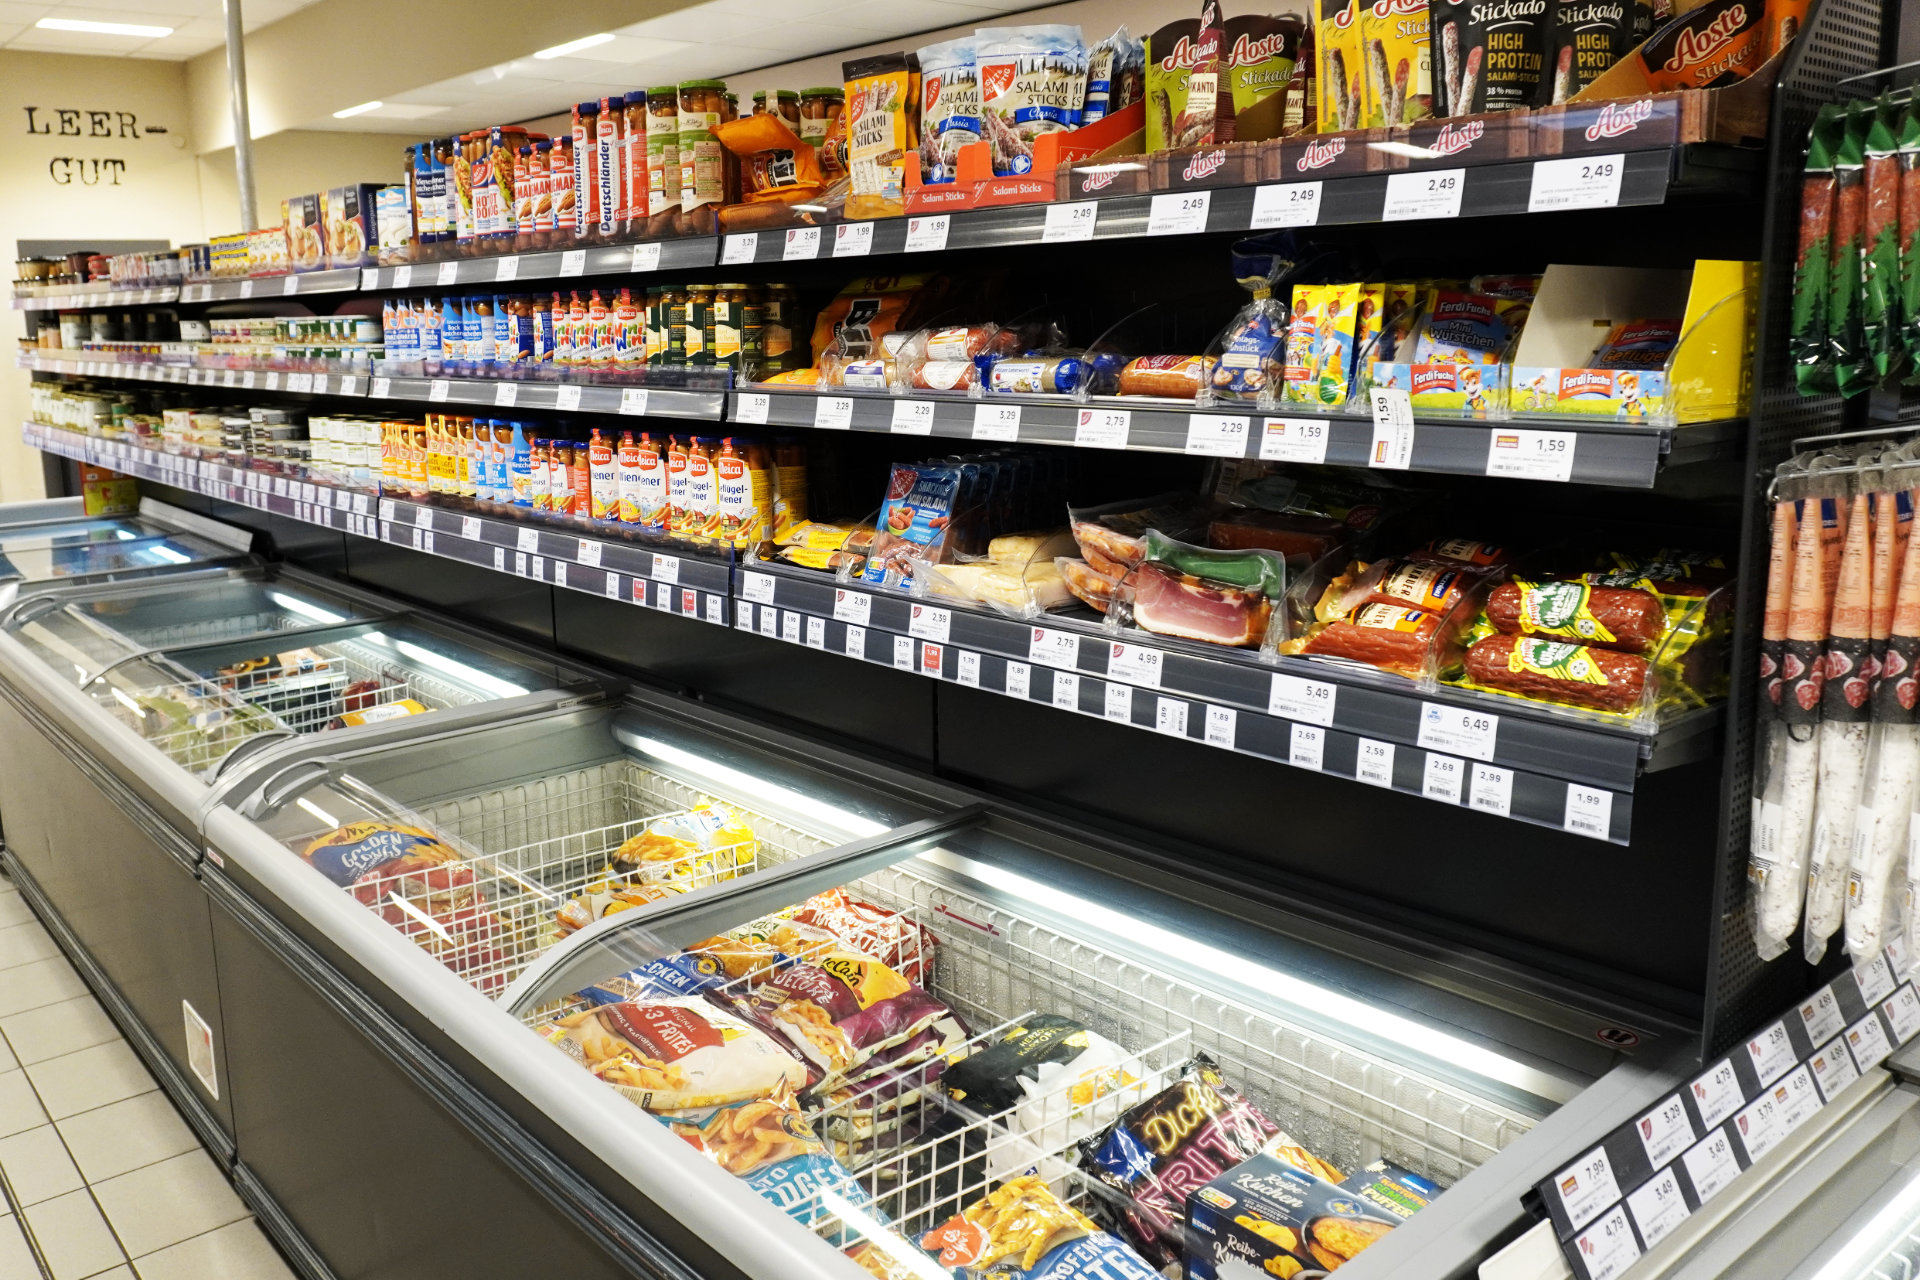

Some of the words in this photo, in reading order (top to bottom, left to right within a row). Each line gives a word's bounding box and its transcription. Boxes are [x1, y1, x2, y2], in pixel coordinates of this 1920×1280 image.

[1468, 0, 1545, 26] Stickado
[1557, 4, 1623, 27] Stickado
[1395, 20, 1431, 39] Stick
[1487, 33, 1523, 51] HIGH
[1576, 33, 1610, 50] HIGH
[1664, 3, 1747, 74] Aoste
[1228, 33, 1284, 72] Aoste
[1487, 51, 1543, 70] PROTEIN
[1015, 81, 1069, 94] SALAMI
[1486, 86, 1496, 96] 38
[940, 91, 978, 106] SALAMI
[1027, 94, 1068, 107] STICKS
[946, 104, 978, 116] SICKS
[24, 106, 168, 139] LEER-
[858, 114, 887, 133] SALAMI
[1585, 99, 1653, 142] Aoste
[855, 129, 883, 148] STICKS
[1429, 119, 1485, 156] Aoste
[1296, 136, 1346, 172] Aoste
[50, 157, 126, 186] GUT
[1183, 149, 1226, 181] Aoste
[1582, 164, 1613, 180] 2,49
[575, 145, 584, 234] Deutschländer
[599, 139, 612, 232] Deutschländer
[992, 185, 1018, 196] Salami
[1019, 183, 1042, 194] Sticks
[1428, 178, 1455, 192] 2,49
[922, 193, 944, 203] Salami
[944, 191, 965, 202] Sticks
[1290, 190, 1314, 203] 2,49
[1182, 199, 1204, 210] 2,49
[1073, 208, 1092, 220] 2,49
[856, 227, 870, 237] 1,99
[930, 222, 945, 231] 1,99
[804, 231, 818, 242] 2,49
[1439, 301, 1464, 313] Ferdi
[1466, 302, 1492, 316] Fuchs
[1449, 321, 1472, 333] Mini
[1429, 327, 1495, 348] Würstchen
[1414, 371, 1433, 386] Ferdi
[1433, 370, 1455, 383] Fuchs
[1562, 374, 1584, 388] Ferdi
[1585, 373, 1612, 387] Fuchs
[836, 401, 849, 411] 2,29
[914, 405, 930, 416] 2,29
[1378, 397, 1390, 424] 1,59
[999, 410, 1016, 421] 3,29
[1105, 416, 1125, 428] 2,79
[1221, 422, 1243, 435] 2,29
[1298, 426, 1322, 439] 1,59
[1536, 438, 1566, 453] 1,59
[619, 451, 639, 463] Meic
[719, 462, 742, 475] Meica
[640, 476, 661, 486] ener
[760, 579, 772, 587] 1,59
[854, 597, 868, 607] 2,99
[932, 613, 947, 623] 2,39
[898, 641, 910, 649] 2,79
[1057, 637, 1075, 649] 2,79
[962, 655, 975, 665] 1,79
[1138, 652, 1157, 665] 4,99
[1011, 666, 1025, 675] 1,89
[1058, 676, 1073, 686] 2,49
[1111, 689, 1126, 699] 1,99
[1306, 685, 1329, 700] 5,49
[1212, 711, 1229, 722] 1,89
[1462, 716, 1490, 732] 6,49
[1297, 730, 1316, 741] 2,69
[1365, 745, 1385, 757] 2,59
[1433, 760, 1454, 772] 2,69
[1479, 771, 1502, 783] 2,99
[1576, 793, 1600, 806] 1,99
[341, 832, 402, 868] GOLDEN
[355, 844, 401, 870] LONGS
[773, 972, 831, 1004] DELUXE
[1818, 993, 1833, 1011] 4,99
[627, 1027, 662, 1057] KARTOFFELIG
[652, 1019, 697, 1055] FRITES
[1768, 1027, 1784, 1046] 2,99
[1715, 1067, 1732, 1087] 4,79
[1792, 1073, 1808, 1091] 4,99
[1144, 1083, 1223, 1154] Dicke
[1663, 1103, 1682, 1124] 3,29
[1757, 1101, 1774, 1121] 3,79
[1707, 1138, 1726, 1159] 3,49
[1584, 1159, 1606, 1181] 7,99
[1237, 1173, 1304, 1208] Kuchen
[1264, 1173, 1309, 1196] Reibe-
[1655, 1179, 1674, 1201] 3,49
[1361, 1187, 1415, 1218] PUFFER
[1192, 1217, 1217, 1236] EDEKA
[1604, 1215, 1625, 1238] 4,79
[1227, 1233, 1261, 1258] Reibe-
